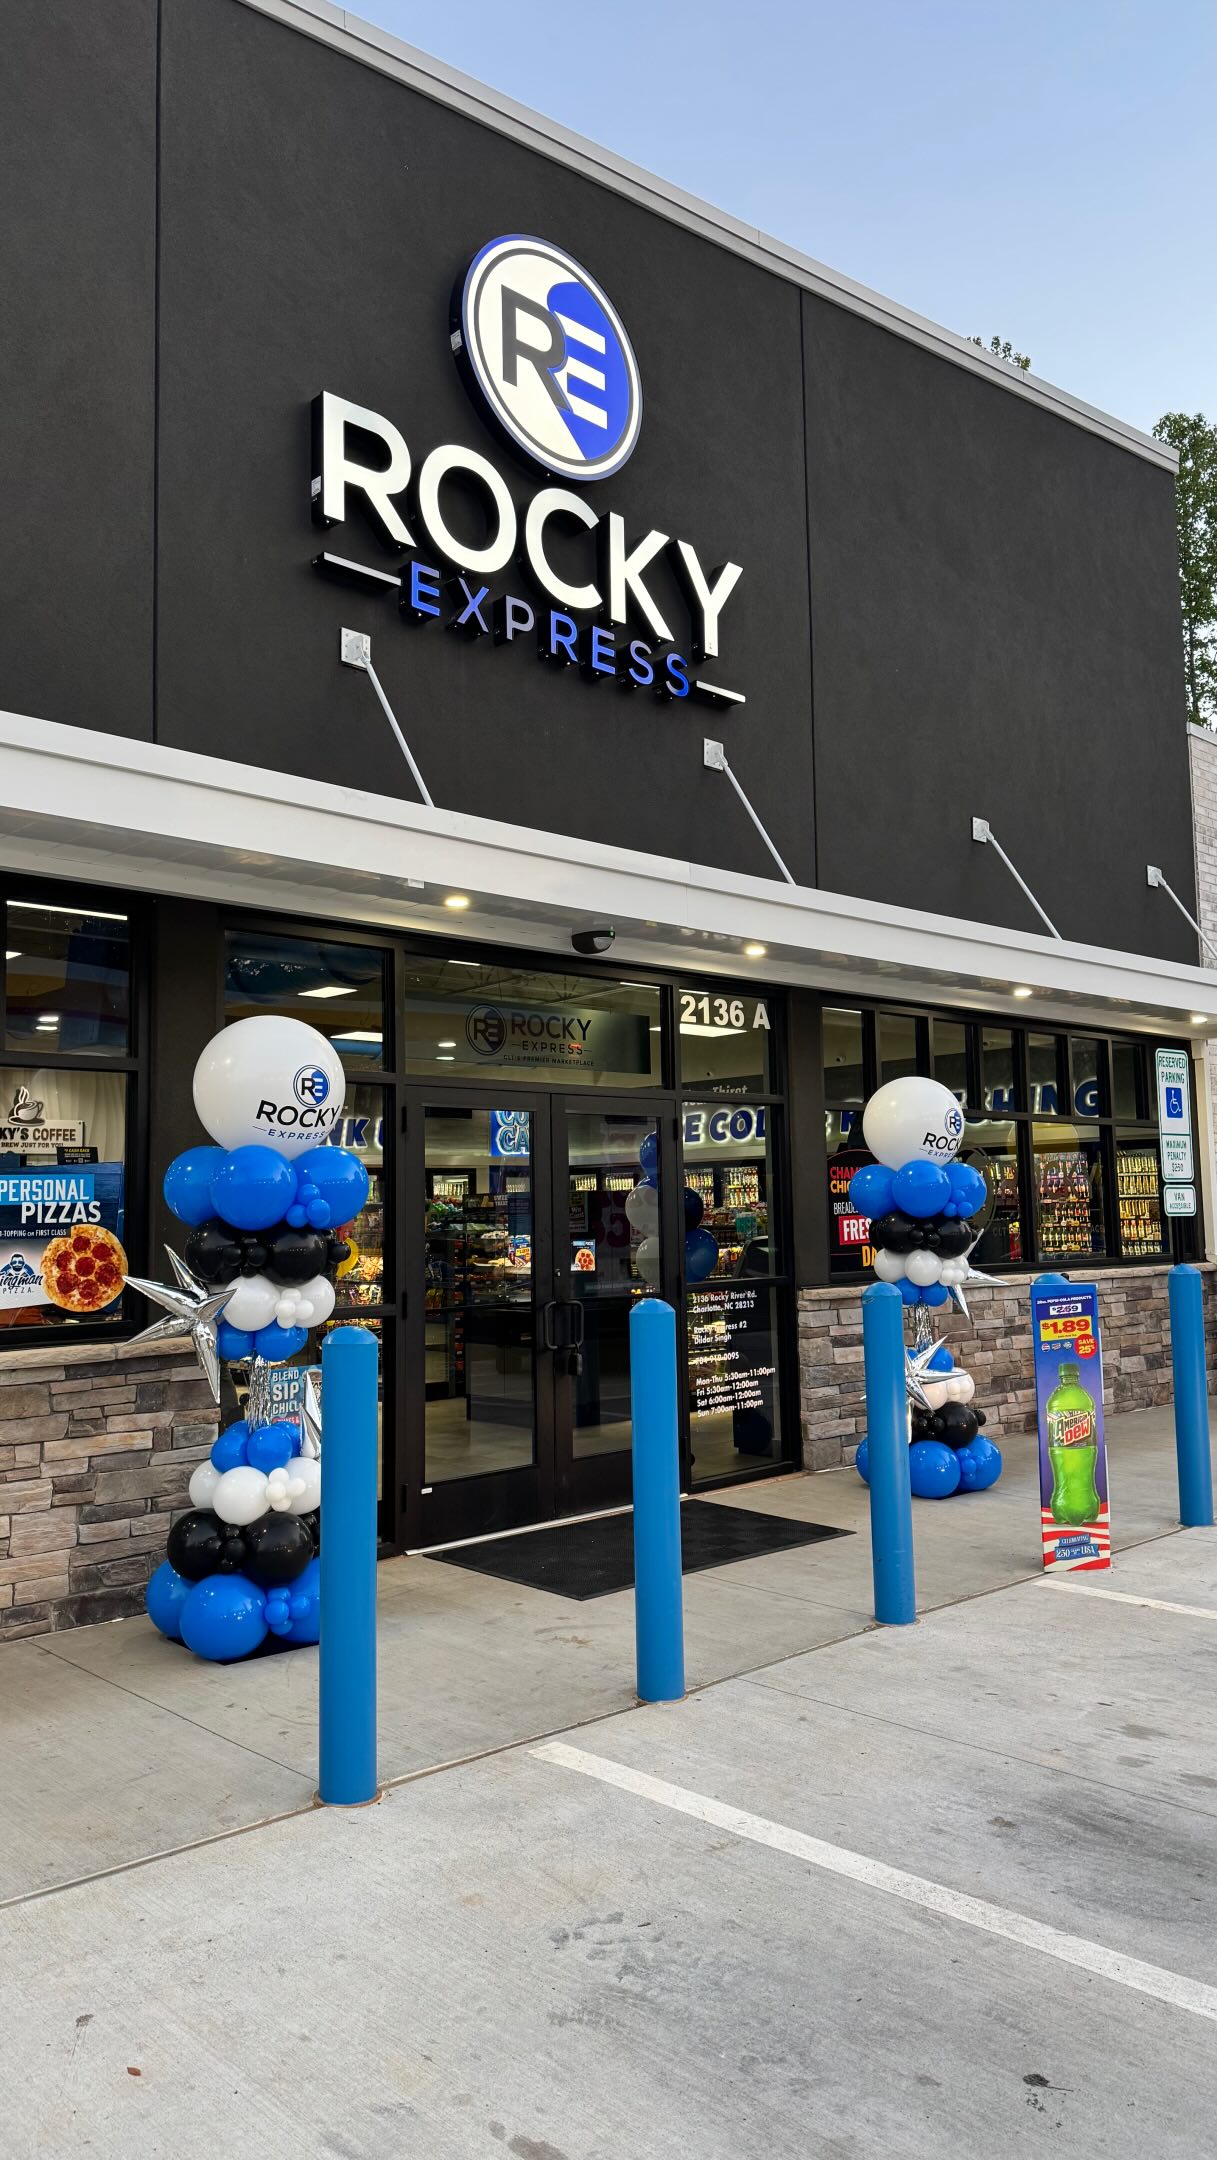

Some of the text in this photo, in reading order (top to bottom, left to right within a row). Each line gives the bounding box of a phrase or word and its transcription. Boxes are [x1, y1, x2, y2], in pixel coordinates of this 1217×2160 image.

[323, 390, 744, 658] ROCKY
[411, 560, 689, 697] EXPRESS
[680, 995, 771, 1030] 2136 A
[511, 1012, 592, 1041] ROCKY
[522, 1040, 583, 1055] EXPRESS
[552, 1057, 595, 1067] MARKETPLACE
[1158, 1055, 1186, 1069] RESERVED
[1161, 1071, 1185, 1084] PARKING
[255, 1099, 340, 1128] ROCKY
[32, 1127, 77, 1142] COFFEE
[268, 1128, 326, 1140] EXPRESS
[1166, 1140, 1187, 1149] MAXIMUM
[1167, 1151, 1187, 1161] PENALTY
[0, 1179, 89, 1201] PERSONAL
[1174, 1192, 1186, 1202] VAN
[21, 1200, 102, 1224] PIZZAS
[35, 1229, 50, 1237] FIRST
[692, 1295, 709, 1304] 2136
[710, 1290, 730, 1302] Rocky
[730, 1291, 746, 1300] River
[724, 1302, 734, 1310] NC
[735, 1300, 755, 1309] 28213
[1042, 1319, 1090, 1333] $1.89
[714, 1332, 732, 1343] Singh
[272, 1369, 299, 1382] BLEND
[695, 1367, 776, 1386] Mon-Thu 5:30am-11:00pm
[272, 1381, 299, 1401] SIP
[696, 1380, 759, 1397] Fri 5:30am-12:00am
[697, 1390, 762, 1407] Sat 6:00am-12:00am
[272, 1401, 299, 1415] CHILL
[697, 1399, 764, 1418] Sun 7:00am-11:00pm
[1056, 1549, 1070, 1558] 250
